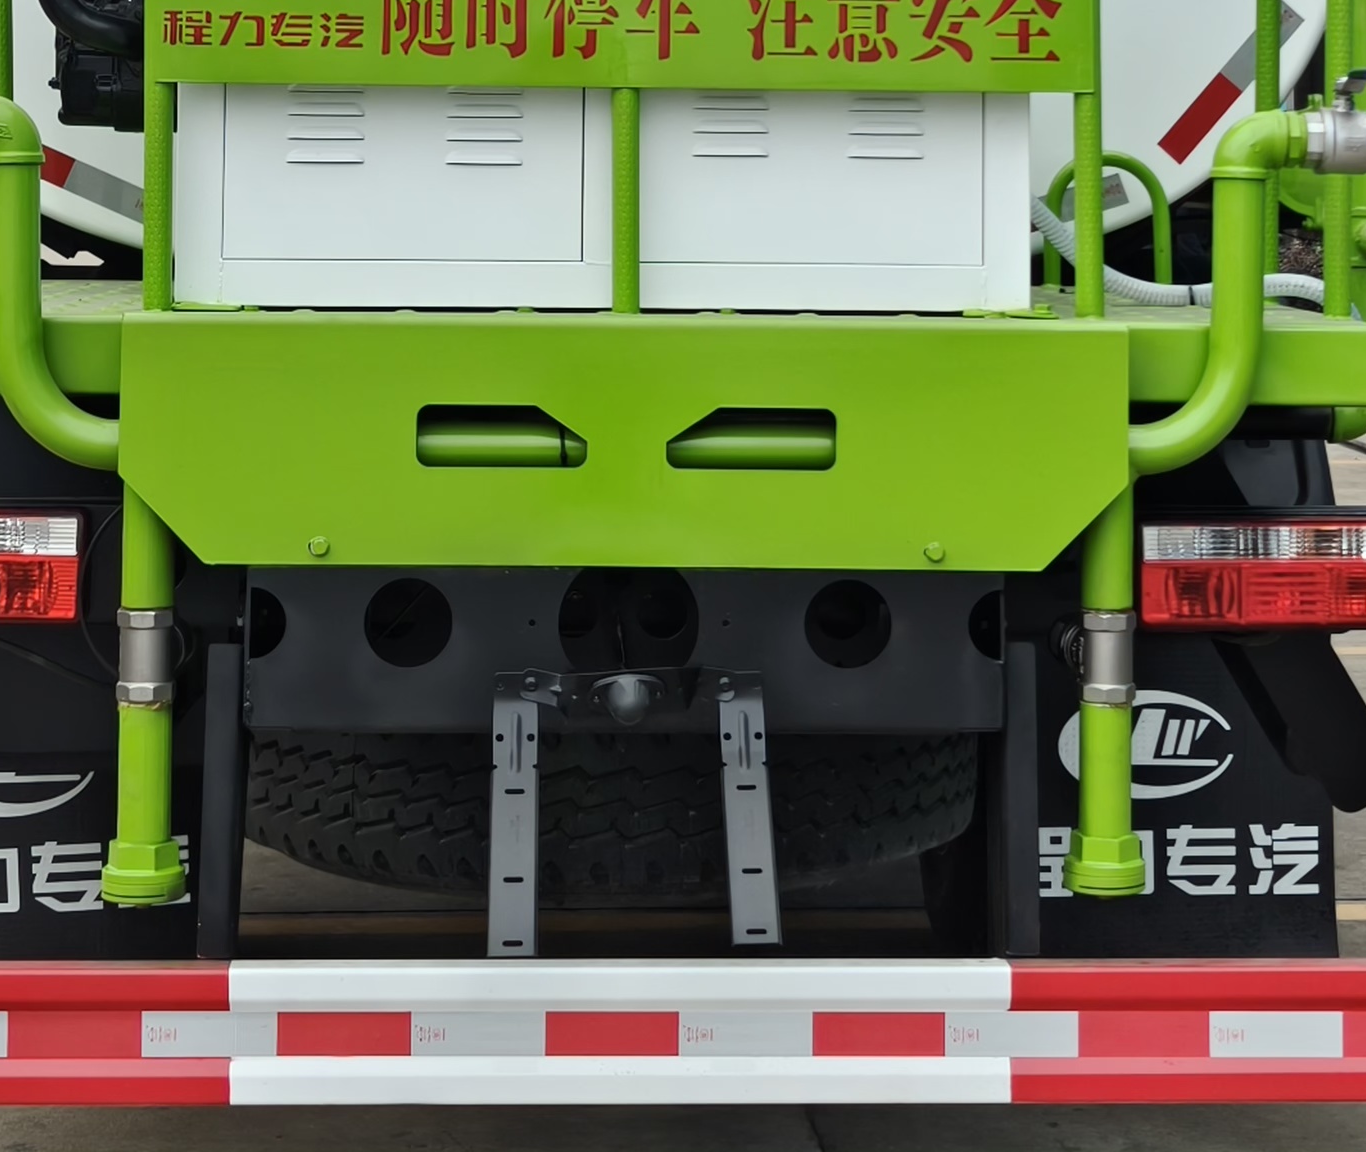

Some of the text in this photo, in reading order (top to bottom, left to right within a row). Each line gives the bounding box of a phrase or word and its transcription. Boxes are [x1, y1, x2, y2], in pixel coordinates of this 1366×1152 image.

[162, 10, 365, 50] 程力专汽
[1038, 822, 1320, 896] 专汽
